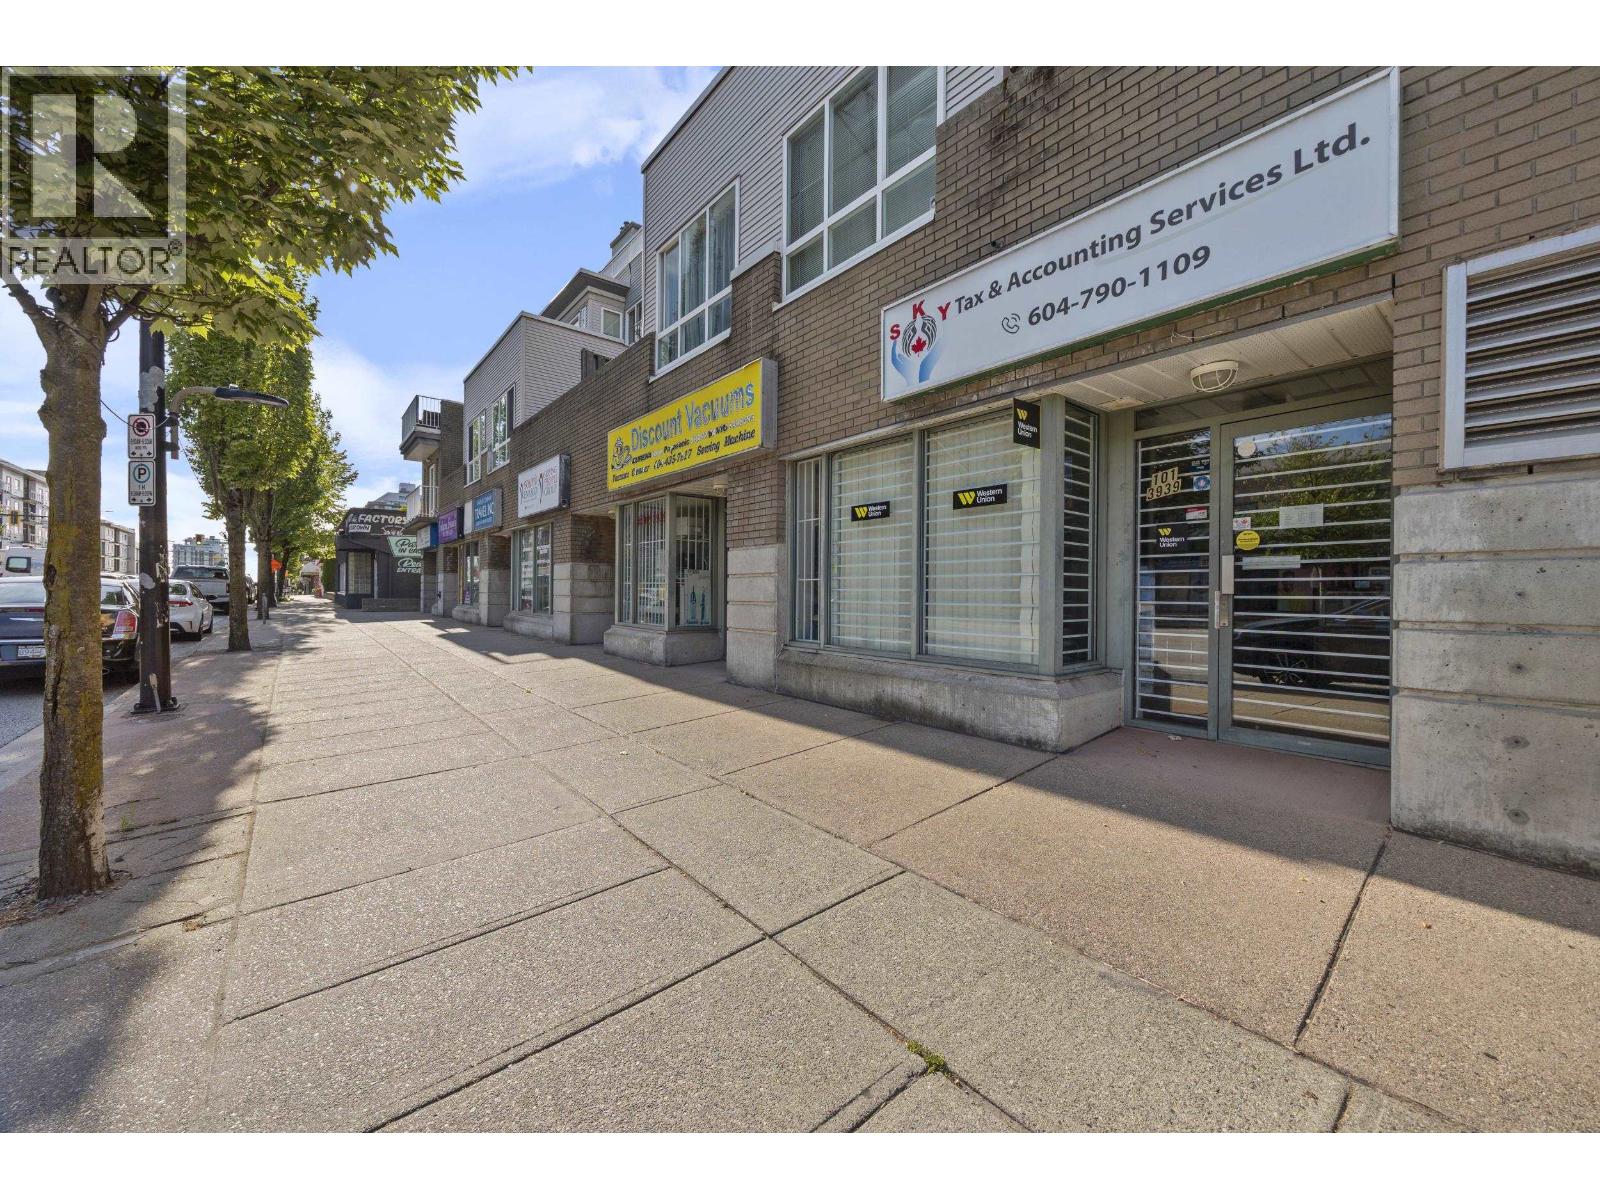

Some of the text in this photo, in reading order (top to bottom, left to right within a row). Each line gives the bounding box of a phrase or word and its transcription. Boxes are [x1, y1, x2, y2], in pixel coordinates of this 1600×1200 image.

[955, 296, 984, 314] Tax
[988, 280, 1002, 299] &
[1007, 223, 1142, 292] Accounting
[1149, 161, 1283, 234] Services
[1293, 122, 1371, 173] Ltd.
[1028, 245, 1212, 327] 604-790-1109
[631, 408, 682, 452] Discount
[685, 383, 755, 431] Vacuums
[1017, 421, 1038, 434] Western
[1017, 428, 1032, 438] Union
[724, 429, 756, 447] Machine
[1153, 469, 1176, 485] 101
[976, 488, 1003, 497] Western
[1148, 480, 1180, 500] 3939
[976, 495, 995, 504] Union
